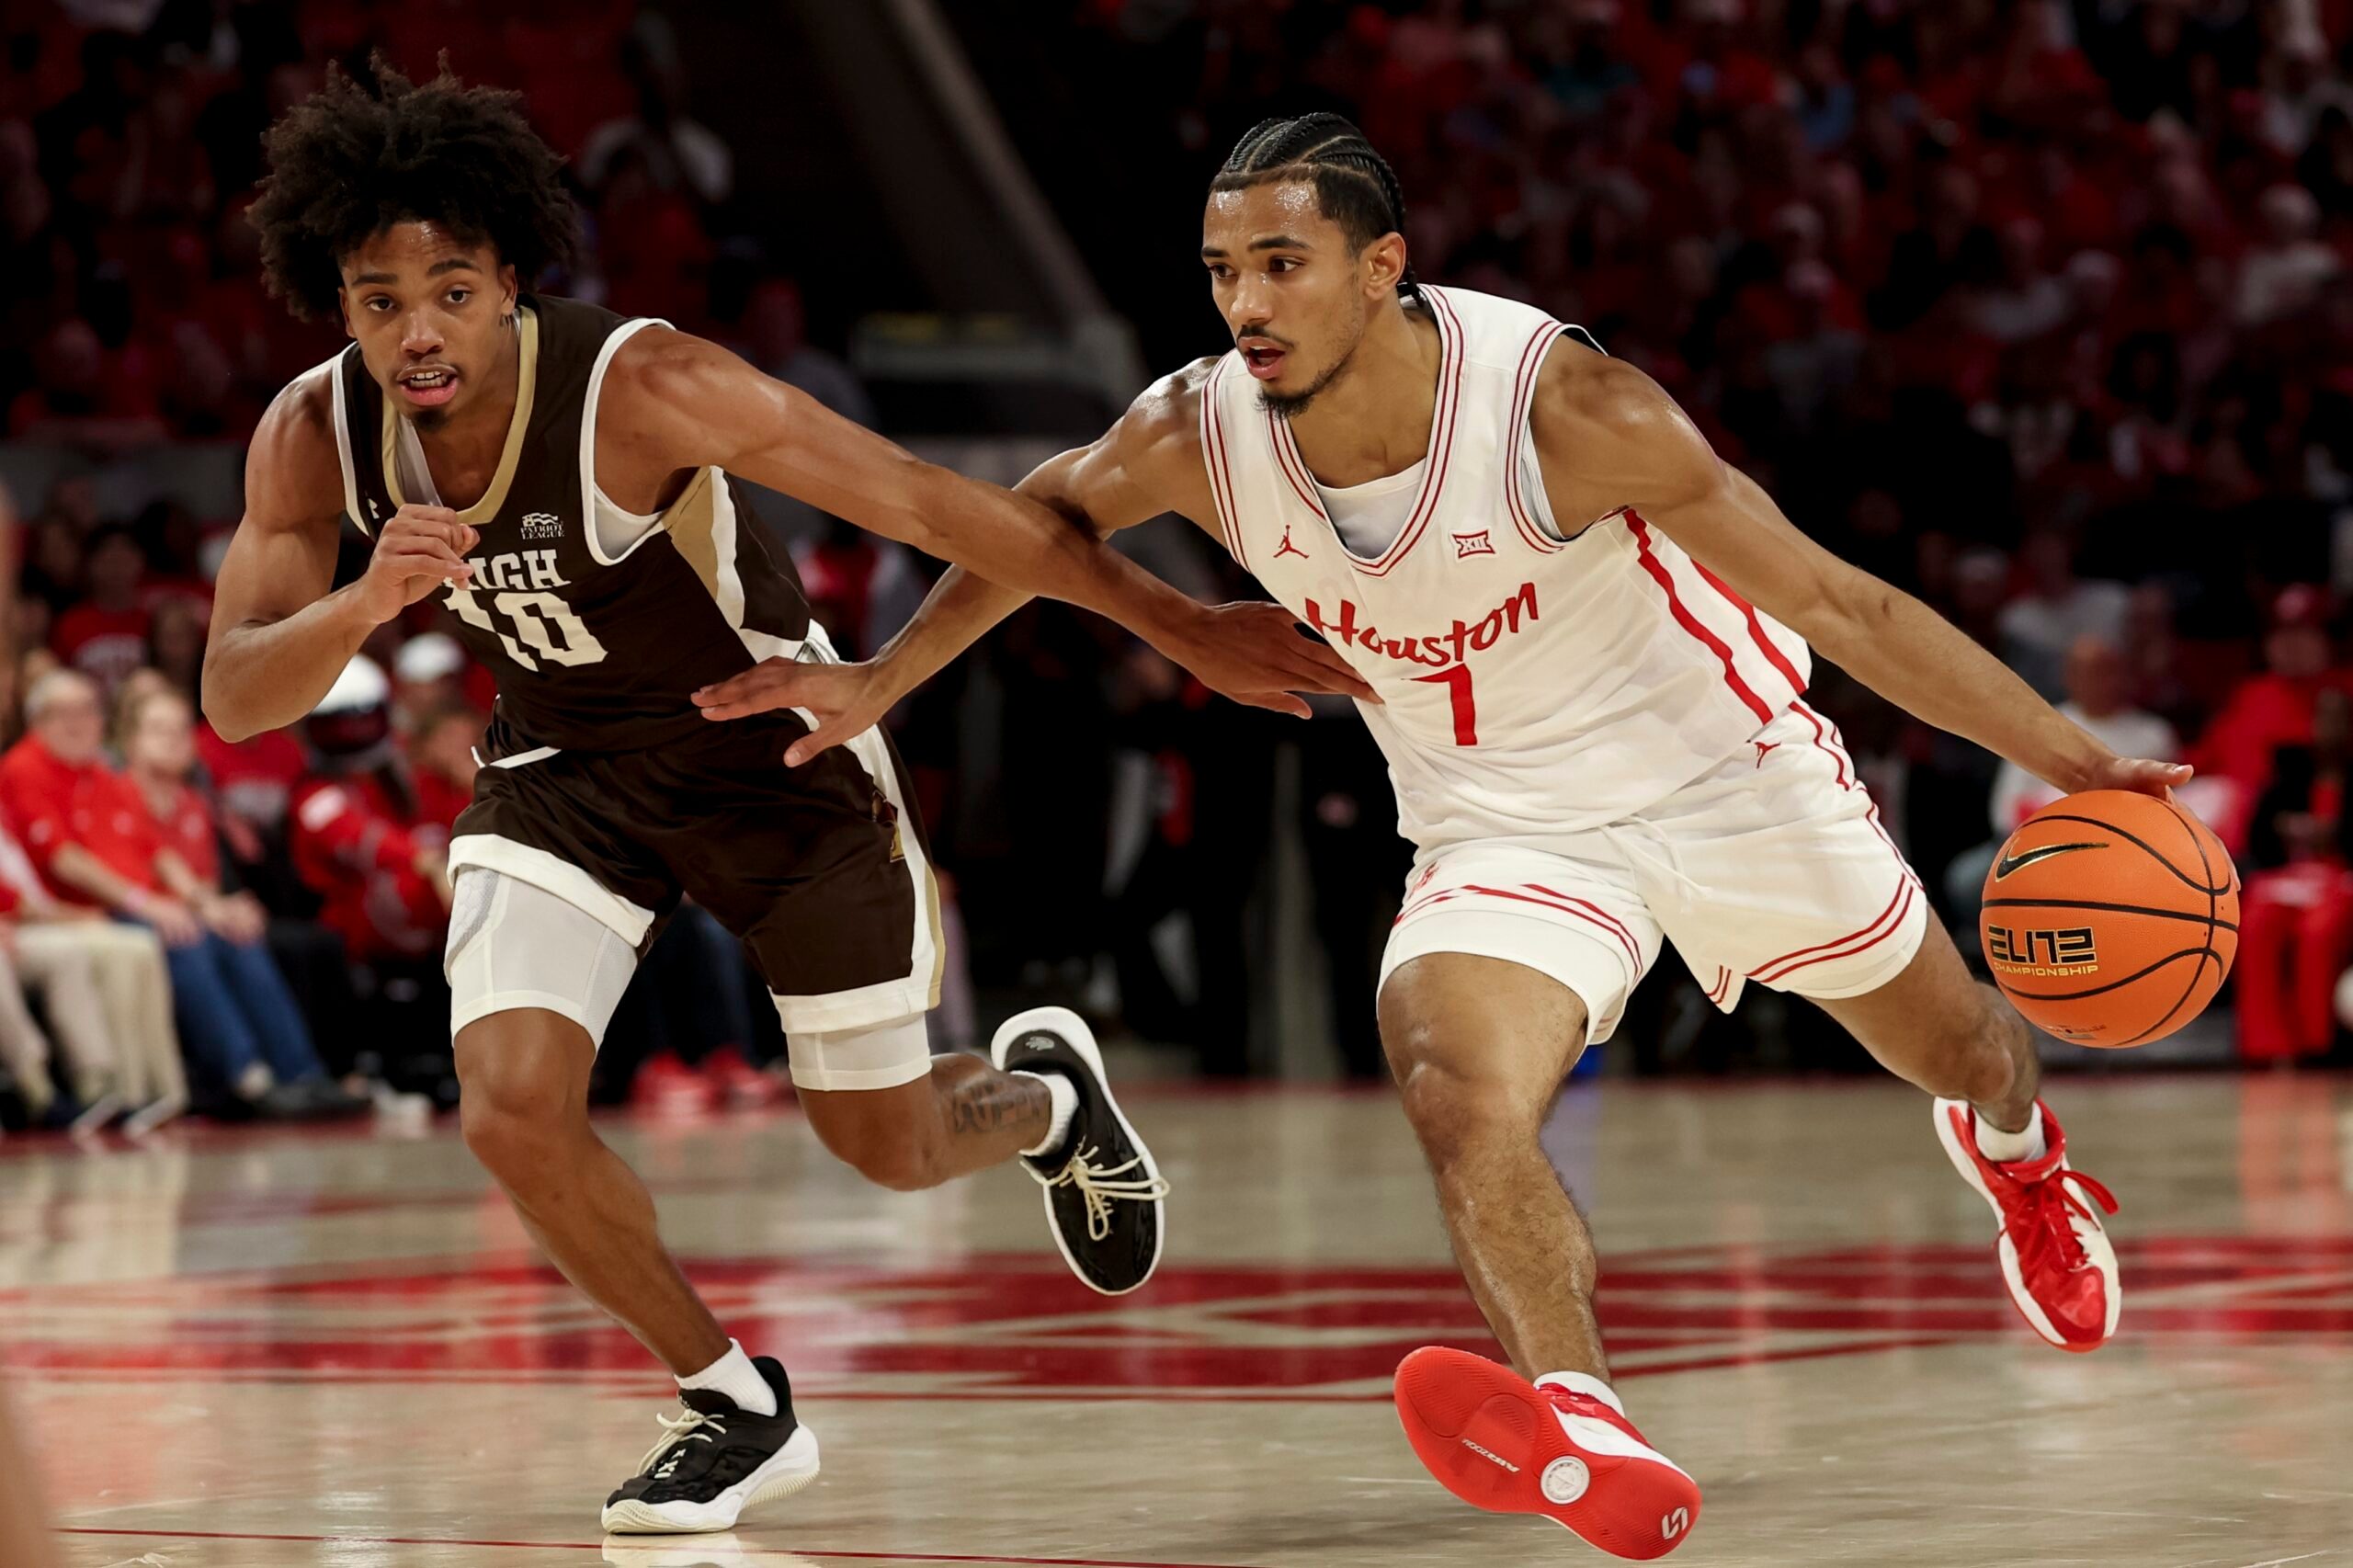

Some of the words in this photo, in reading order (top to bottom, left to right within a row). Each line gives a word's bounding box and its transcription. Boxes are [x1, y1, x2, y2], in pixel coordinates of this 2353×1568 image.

[520, 524, 563, 533] PATRIOT
[522, 530, 565, 540] LEAGUE
[442, 586, 608, 672] 10
[1302, 582, 1539, 666] Houston
[1987, 923, 2097, 966] ELITE
[1993, 961, 2098, 976] CHAMPIONSHIP
